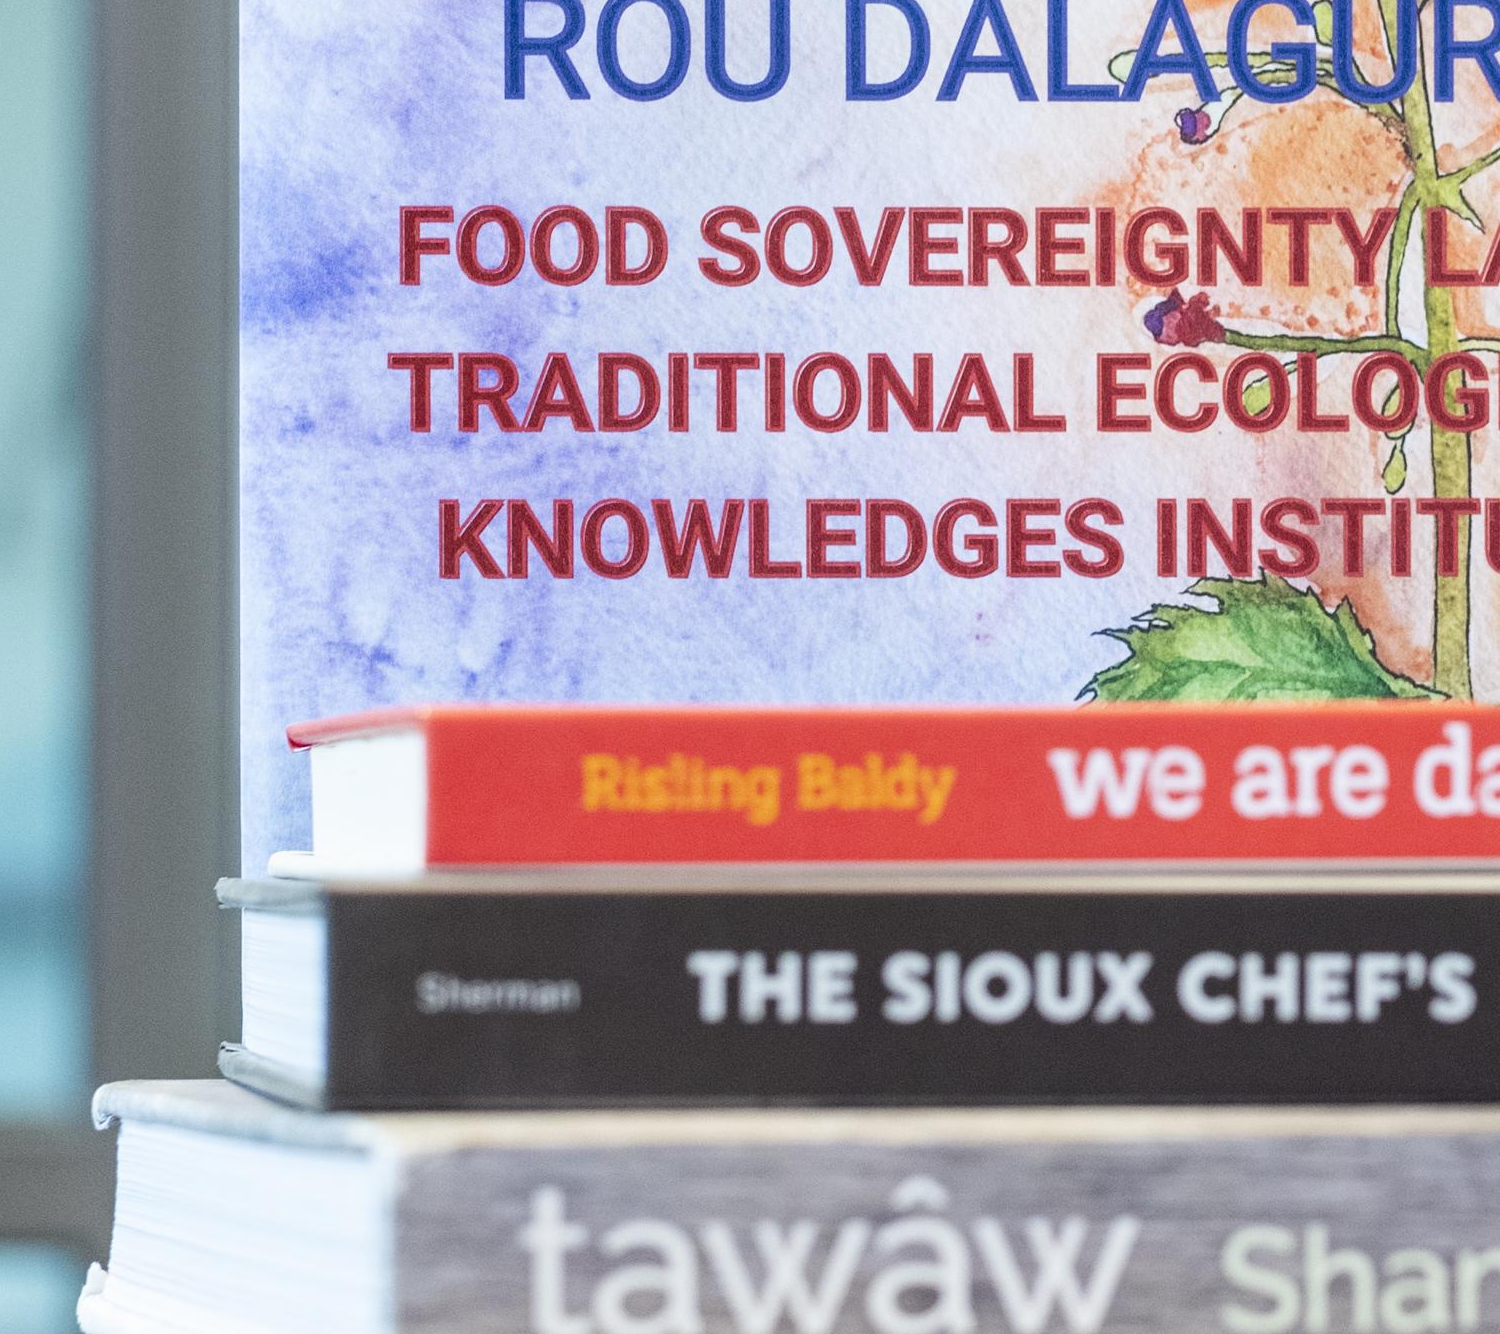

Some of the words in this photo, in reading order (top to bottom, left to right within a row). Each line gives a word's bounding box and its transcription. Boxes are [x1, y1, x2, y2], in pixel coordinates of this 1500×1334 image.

[399, 205, 669, 287] FOOD
[697, 205, 1393, 289] SOVEREIGNTY
[389, 353, 1067, 434] TRADITIONAL
[438, 497, 1126, 581] KNOWLEDGES
[580, 752, 780, 825] Risling
[797, 752, 955, 825] Baldy
[1050, 747, 1204, 820] we
[1231, 747, 1388, 819] are
[688, 951, 858, 1023] THE
[883, 951, 1154, 1023] SIOUX
